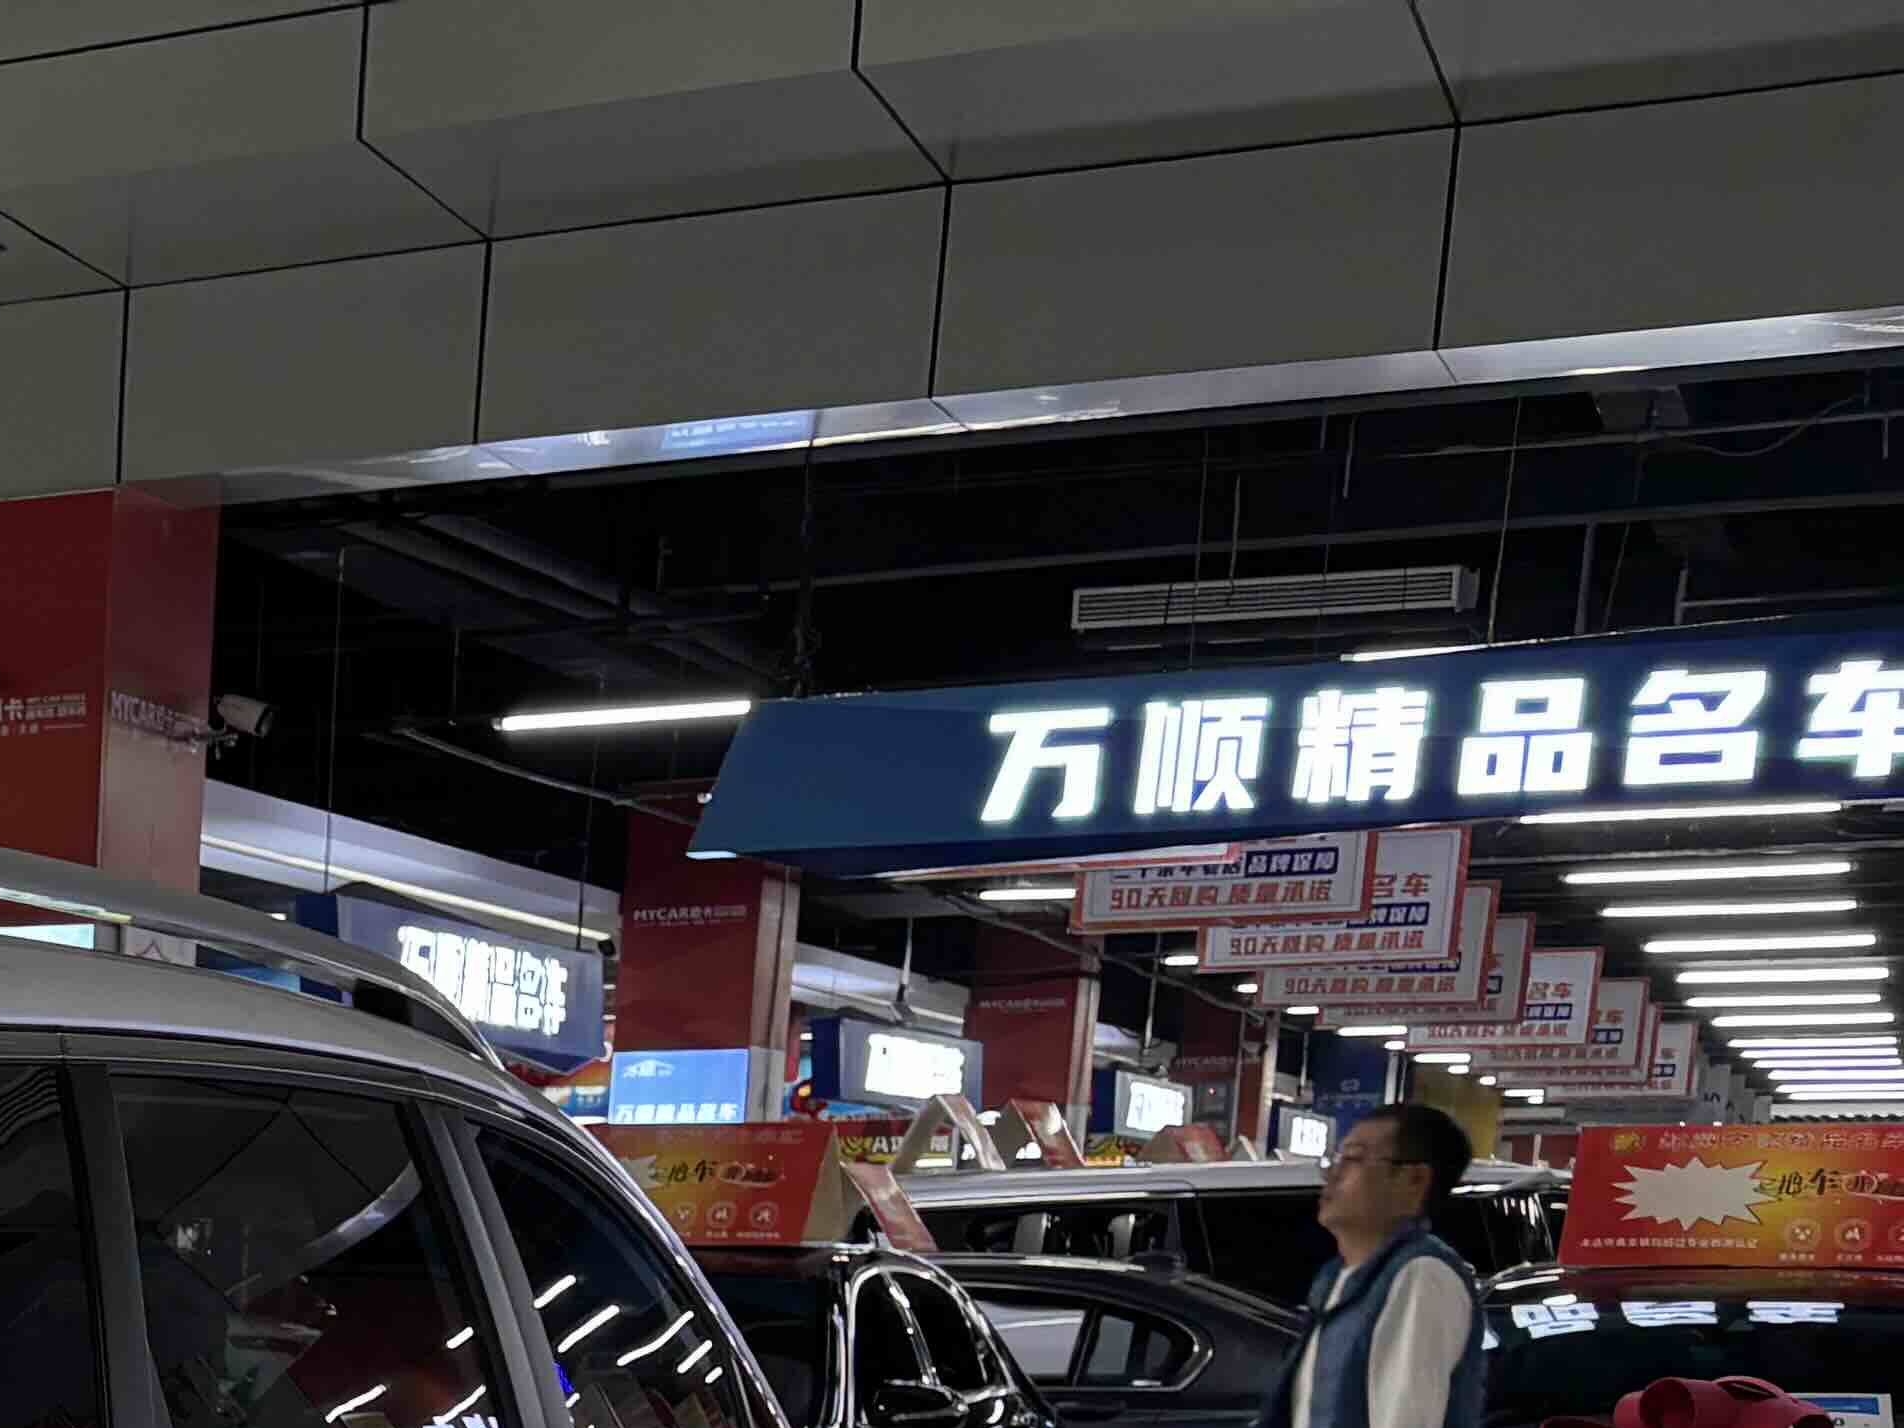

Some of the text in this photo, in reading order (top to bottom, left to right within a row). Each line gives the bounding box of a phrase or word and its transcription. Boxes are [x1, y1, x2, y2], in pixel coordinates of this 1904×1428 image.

[980, 660, 1904, 824] 万顺精品名车
